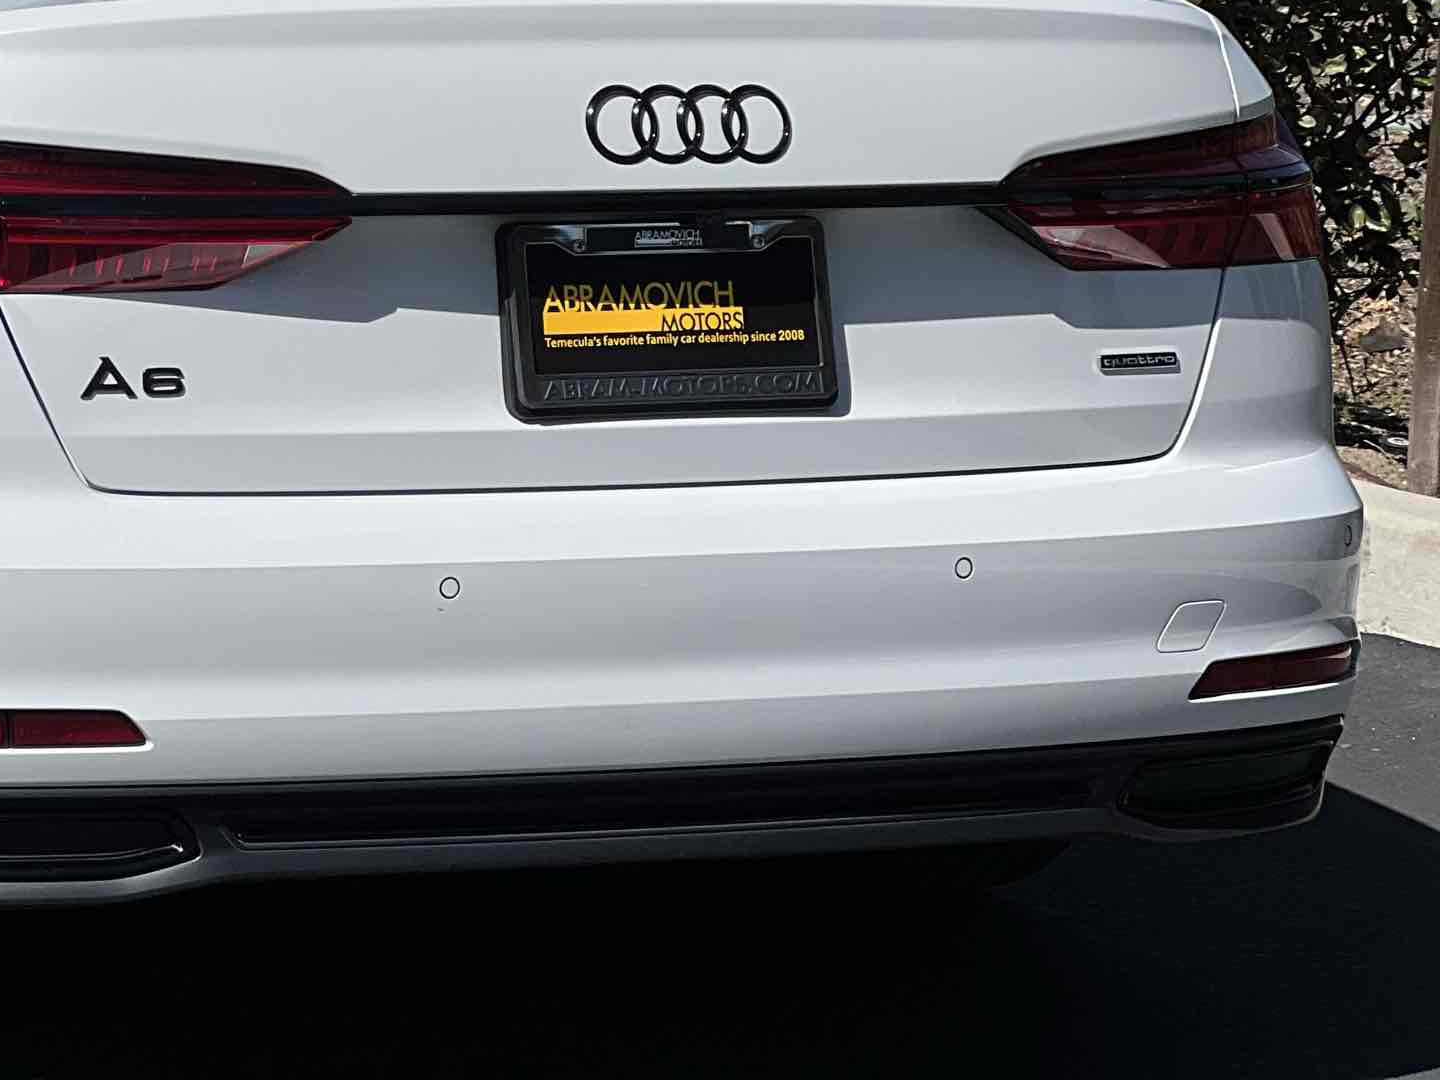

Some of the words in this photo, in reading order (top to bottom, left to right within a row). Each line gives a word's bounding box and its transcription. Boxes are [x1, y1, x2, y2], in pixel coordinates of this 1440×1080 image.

[544, 280, 734, 312] ABRAMOVICH
[661, 310, 744, 332] MOTORS
[544, 337, 601, 348] Temecula's
[603, 334, 645, 346] favorite
[645, 333, 679, 347] family
[680, 334, 696, 344] car
[698, 330, 749, 344] dealership
[751, 331, 777, 342] since
[778, 329, 805, 341] 2008
[1103, 355, 1175, 367] quattro
[80, 356, 186, 400] A6
